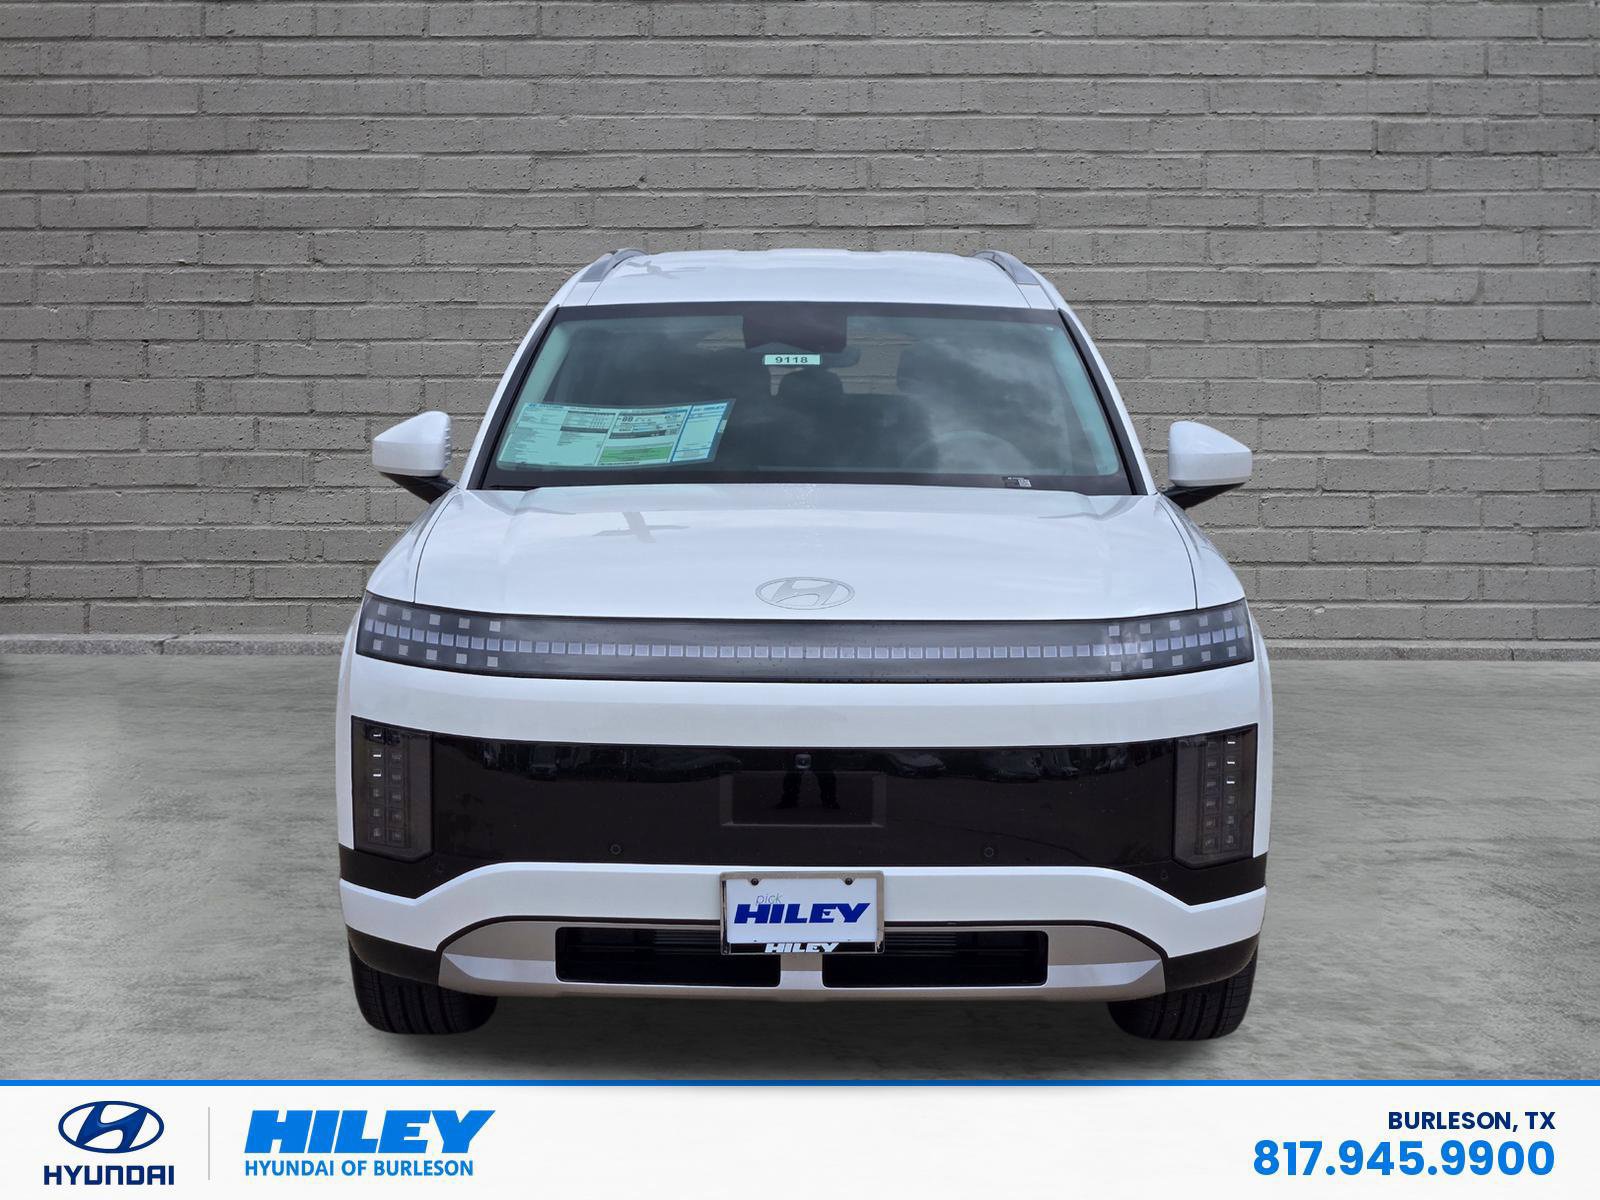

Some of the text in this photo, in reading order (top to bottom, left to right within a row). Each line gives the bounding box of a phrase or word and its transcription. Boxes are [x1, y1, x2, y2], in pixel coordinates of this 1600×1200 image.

[775, 356, 808, 364] 9118
[755, 893, 783, 906] pick
[734, 903, 871, 924] HILEY
[765, 942, 840, 953] HILEY
